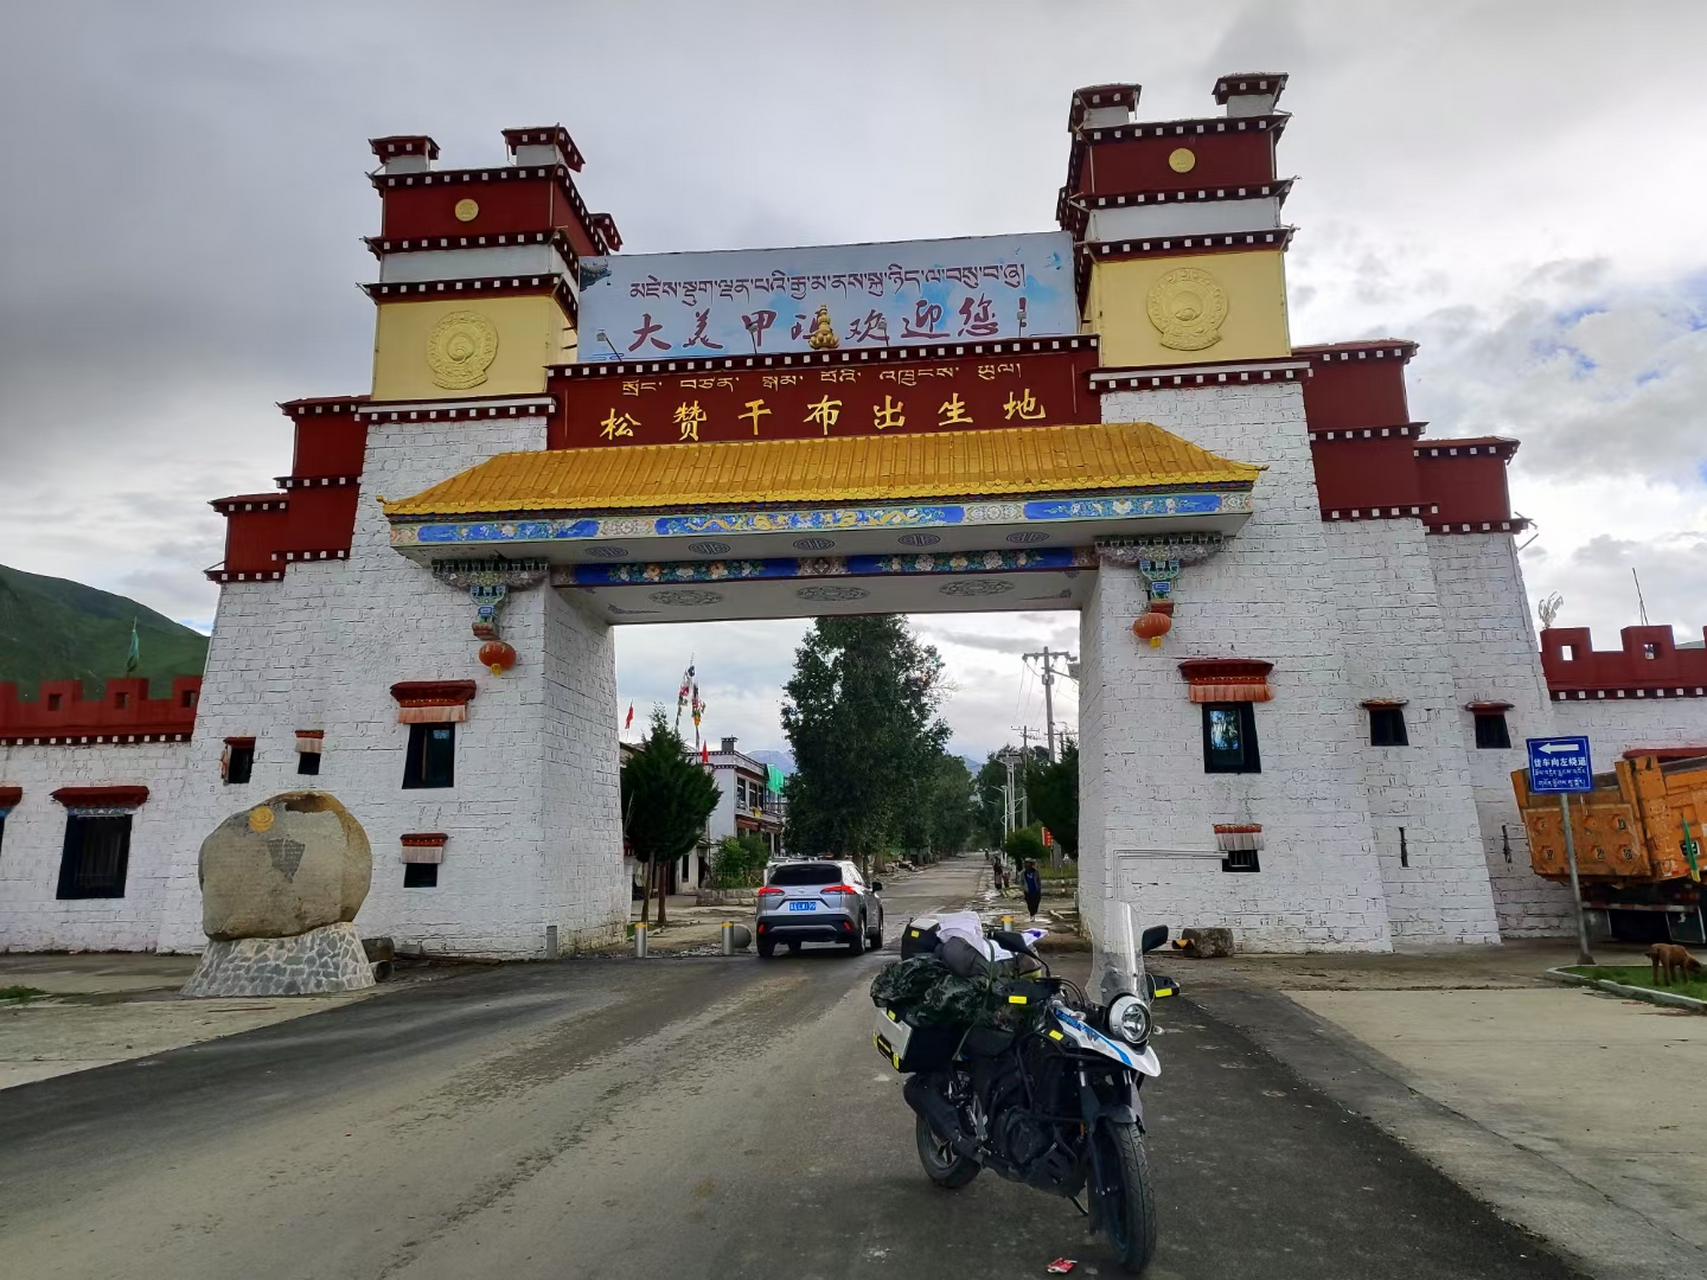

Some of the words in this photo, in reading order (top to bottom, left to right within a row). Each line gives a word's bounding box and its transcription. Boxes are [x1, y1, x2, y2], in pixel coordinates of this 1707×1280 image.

[600, 388, 1046, 441] 松赞干布出生地
